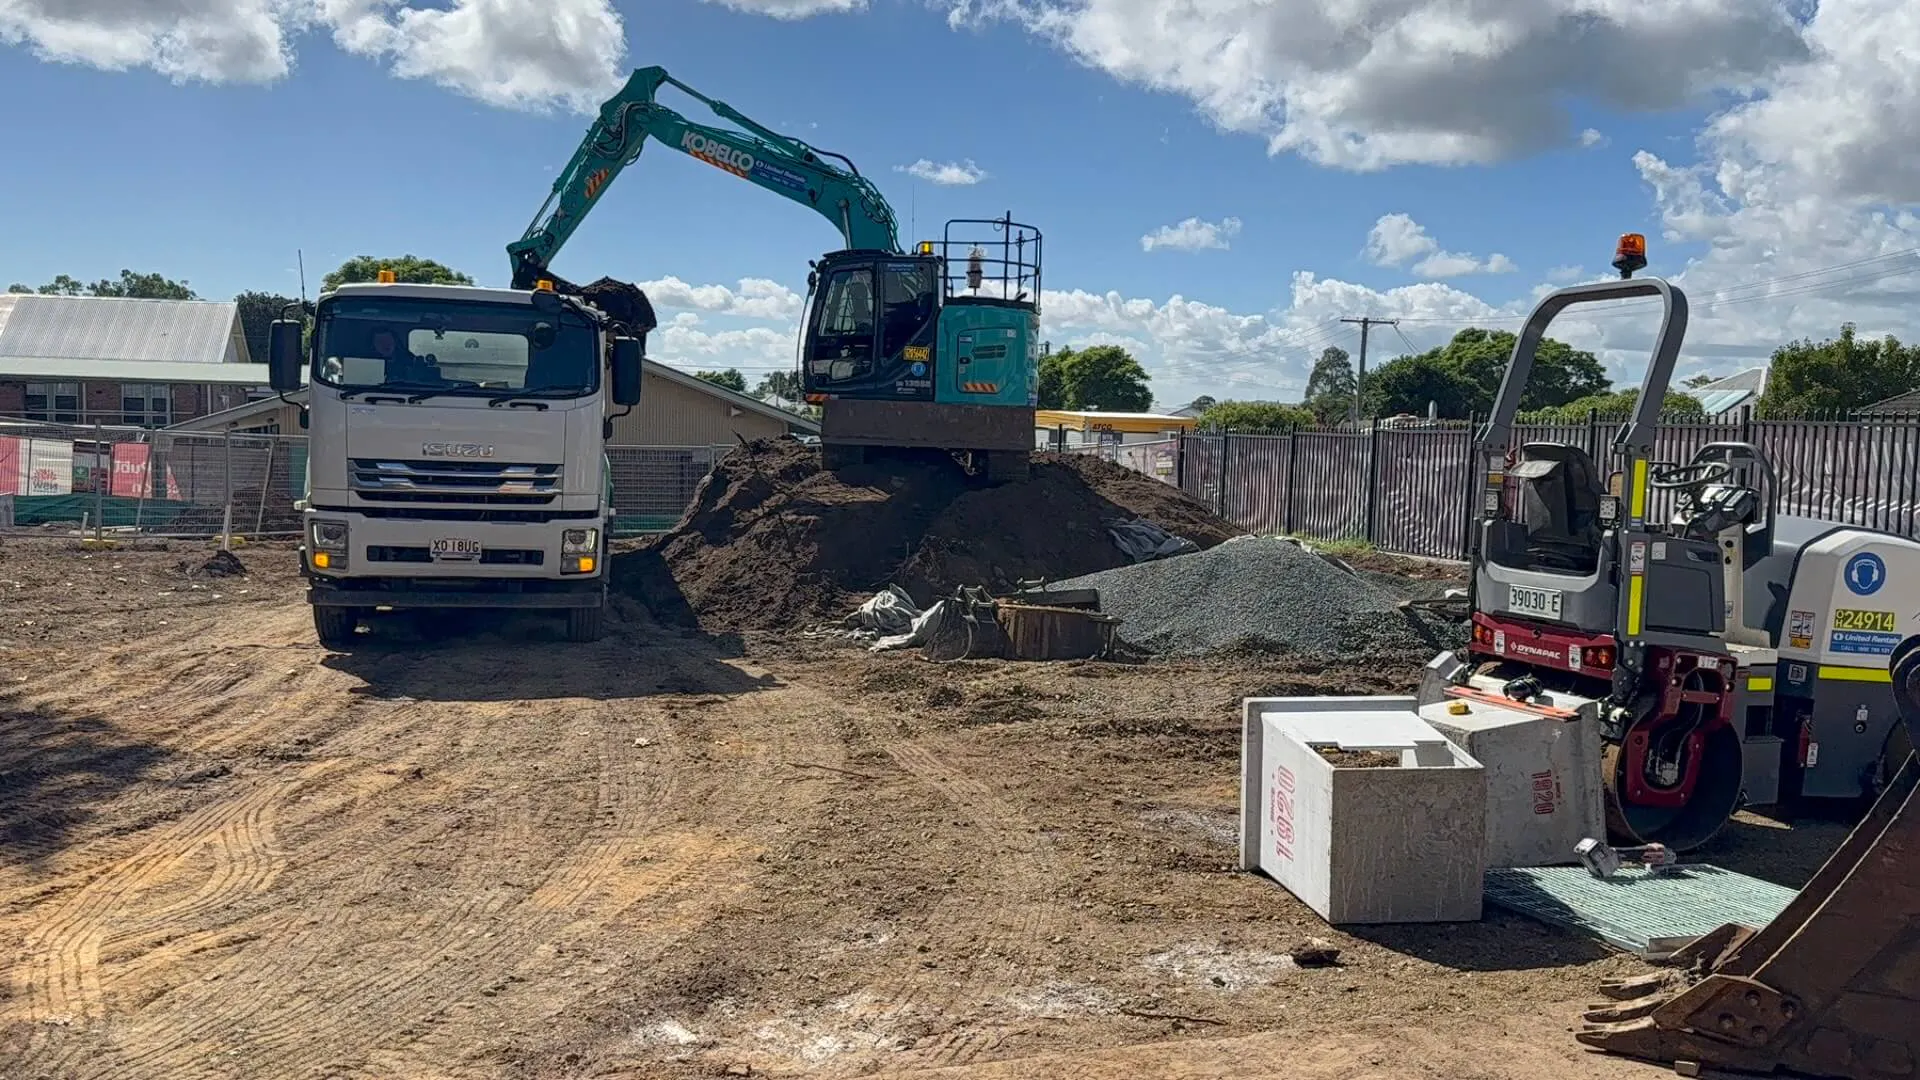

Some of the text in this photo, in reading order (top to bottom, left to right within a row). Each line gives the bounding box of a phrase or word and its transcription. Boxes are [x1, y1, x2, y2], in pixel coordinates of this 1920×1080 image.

[681, 130, 755, 171] KOBELCO
[422, 443, 495, 458] ISUZU
[1843, 611, 1893, 631] 24914
[1845, 634, 1871, 642] United
[1517, 645, 1560, 659] DYNAPAC
[1531, 769, 1554, 815] 1920
[1276, 765, 1295, 862] 1920
